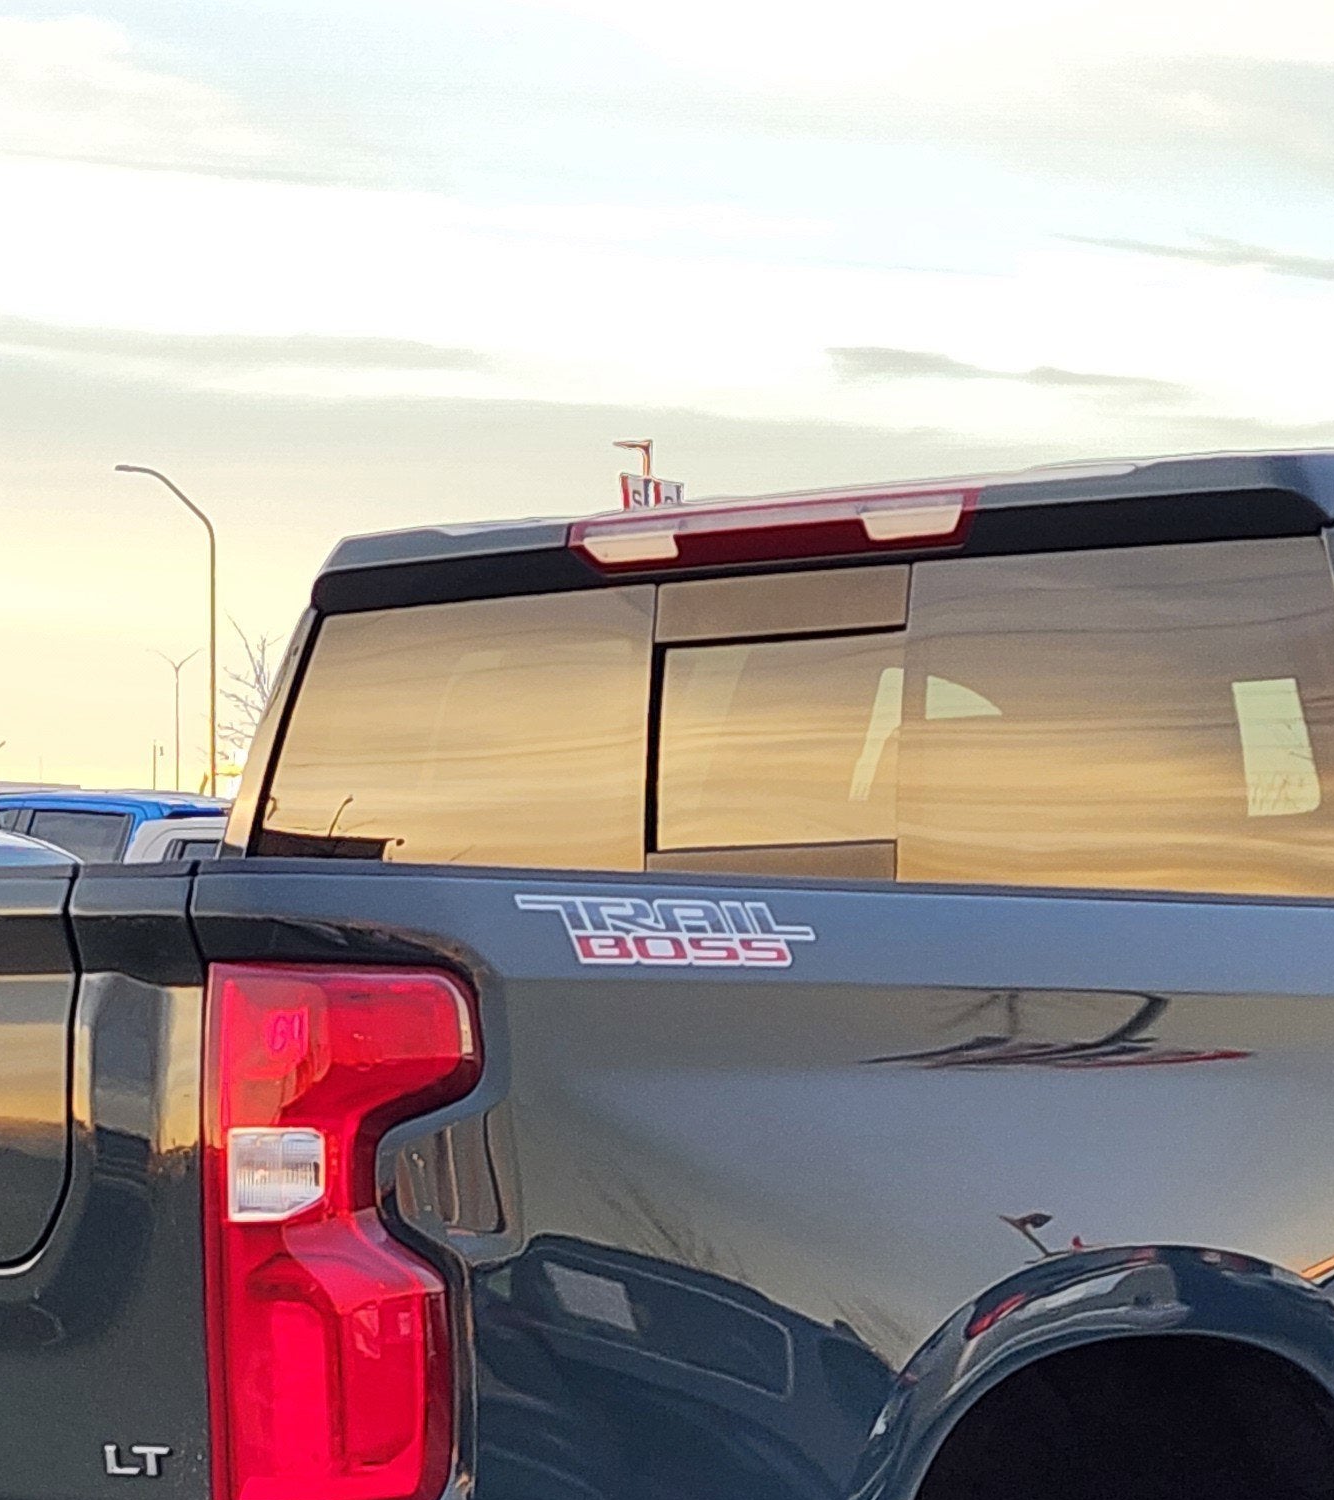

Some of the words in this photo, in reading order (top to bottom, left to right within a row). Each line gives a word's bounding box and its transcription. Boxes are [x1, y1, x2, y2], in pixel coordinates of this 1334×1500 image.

[515, 894, 816, 941] TRAIL
[574, 932, 793, 967] BOSS
[104, 1444, 170, 1476] LT
